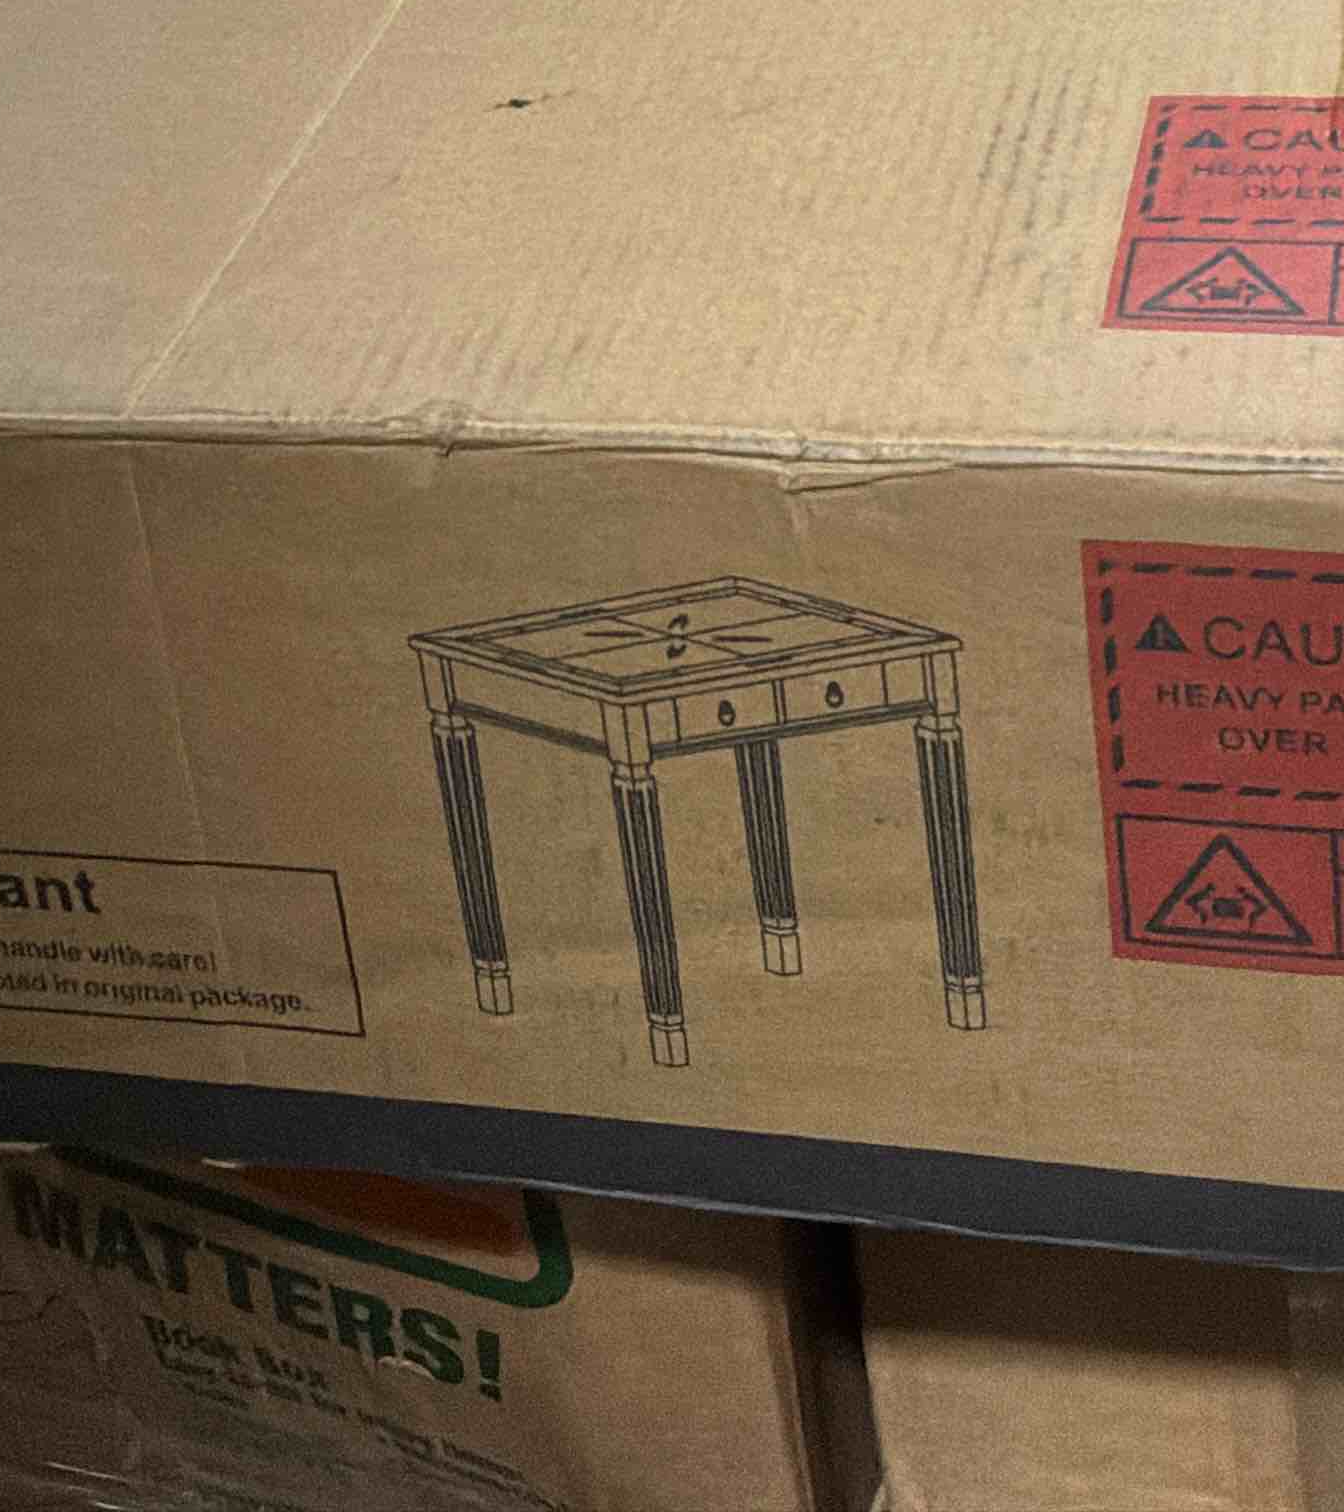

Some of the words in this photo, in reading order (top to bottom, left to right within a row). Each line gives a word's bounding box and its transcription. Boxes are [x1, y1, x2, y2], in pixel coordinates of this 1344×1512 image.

[1190, 161, 1306, 179] HEAVY
[1241, 186, 1343, 202] OVER
[1156, 681, 1285, 714] HEAVY
[1218, 725, 1330, 756] OVER
[87, 940, 145, 970] with
[52, 973, 78, 995] in
[83, 978, 184, 1006] original
[189, 985, 314, 1016] package.
[8, 1165, 505, 1405] MATTERS!
